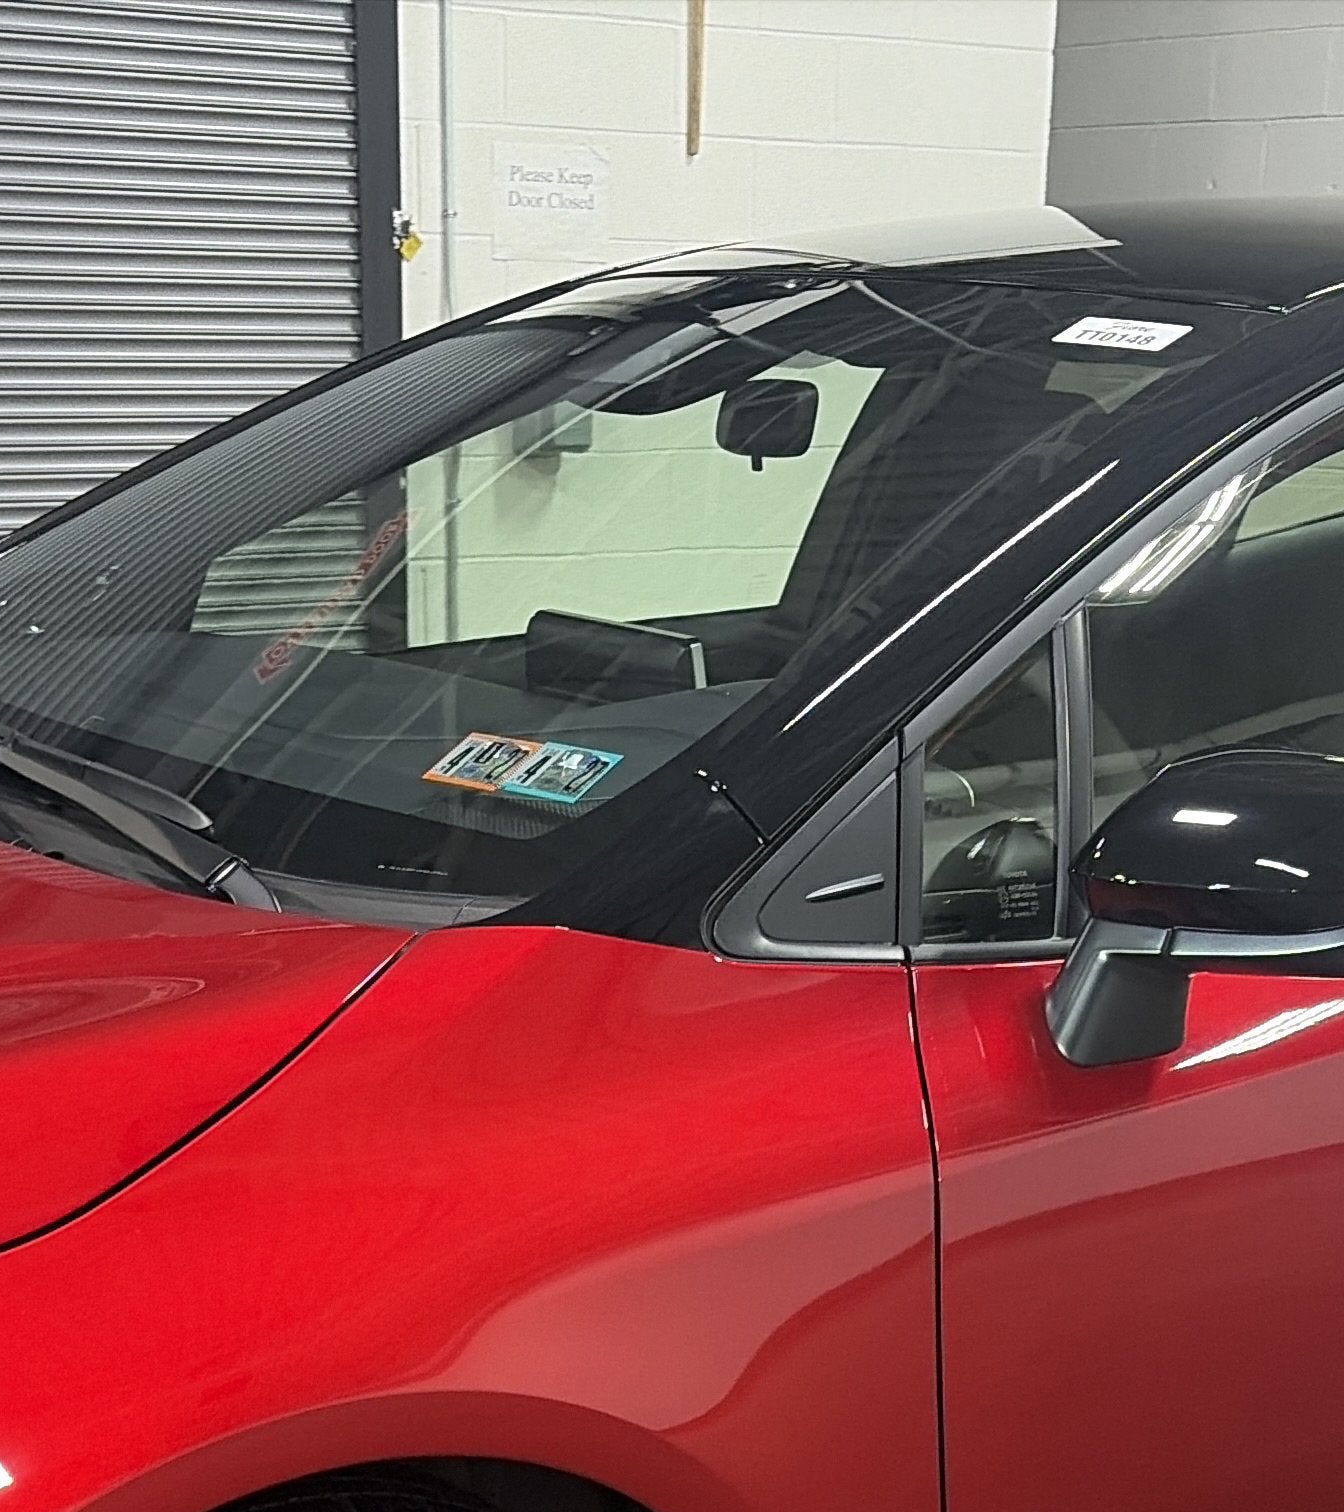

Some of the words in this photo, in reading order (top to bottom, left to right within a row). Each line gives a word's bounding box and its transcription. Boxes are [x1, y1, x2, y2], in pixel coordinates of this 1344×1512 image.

[509, 165, 553, 183] Please
[557, 168, 594, 188] Keep
[508, 191, 544, 207] Door
[547, 192, 594, 210] Closed
